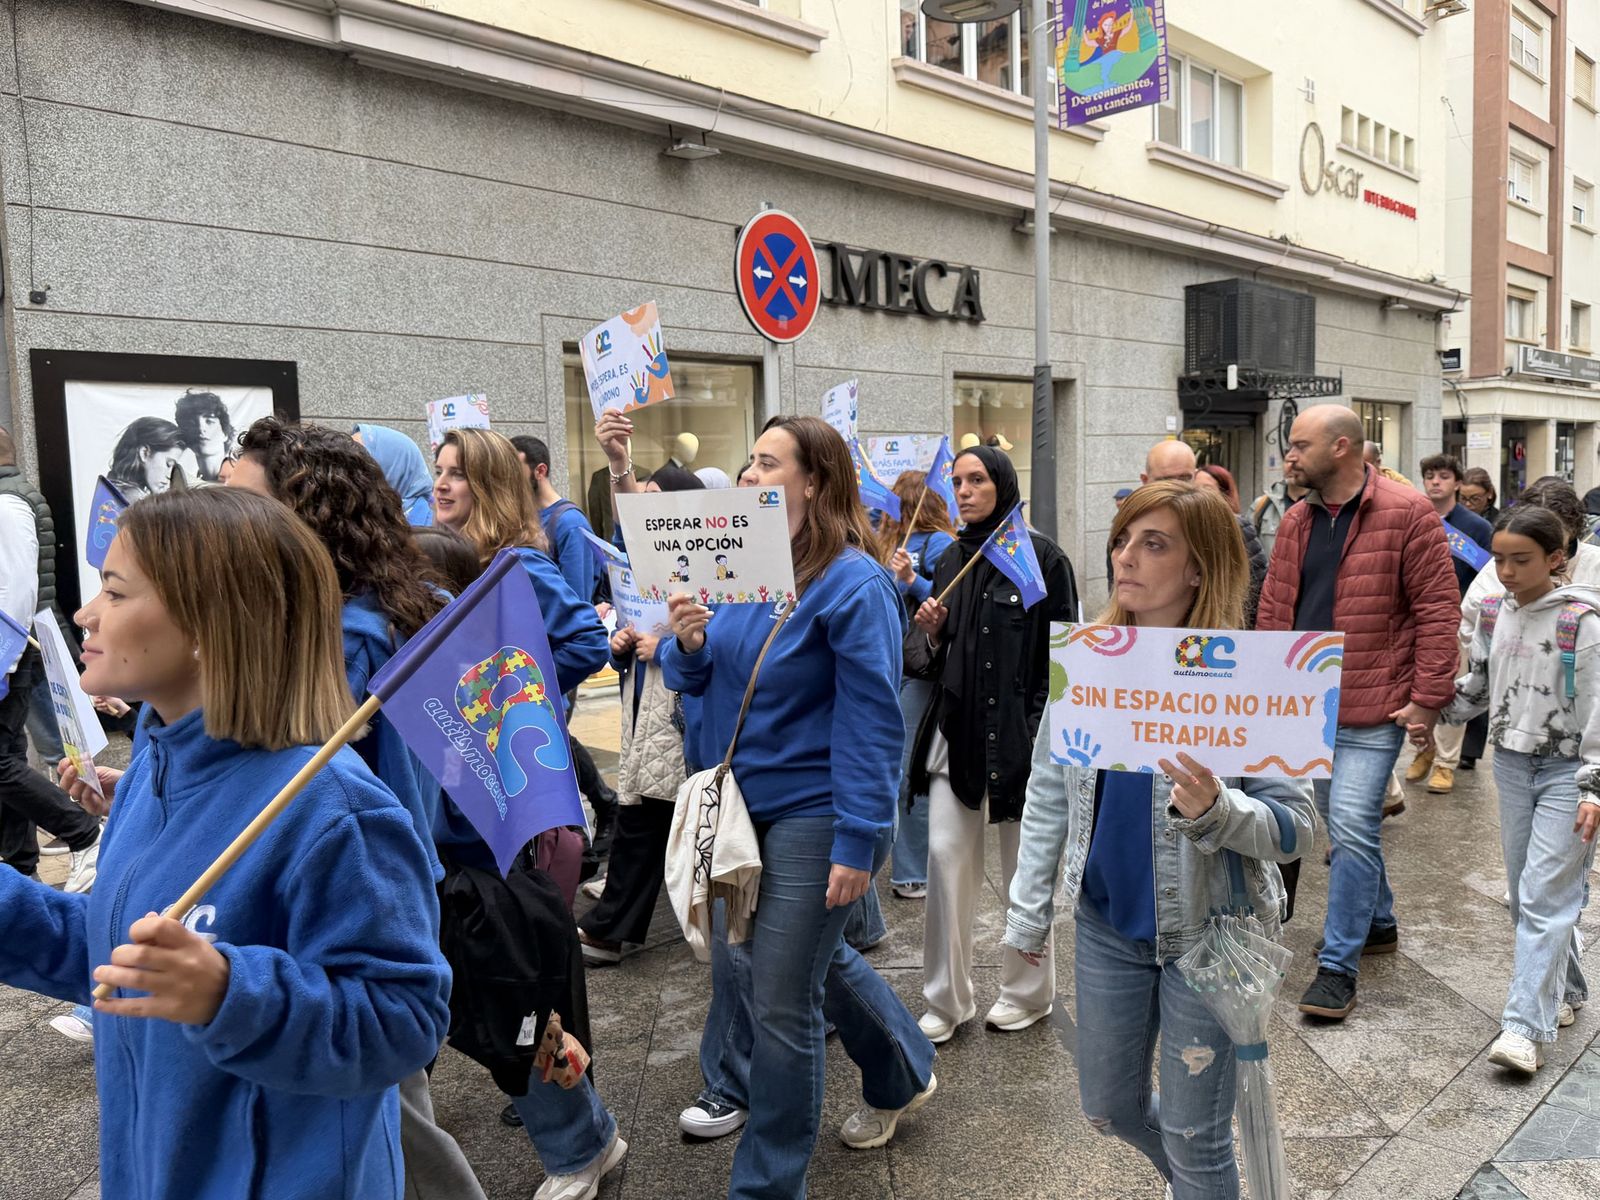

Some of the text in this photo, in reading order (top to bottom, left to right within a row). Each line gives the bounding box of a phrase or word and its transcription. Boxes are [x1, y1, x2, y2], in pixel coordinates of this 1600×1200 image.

[1071, 95, 1092, 107] Dos
[1085, 92, 1142, 116] una canción
[1299, 121, 1364, 200] Oscar
[645, 515, 749, 531] ESPERAR NO ES
[654, 533, 744, 551] UNA OPCIÓN
[1071, 685, 1316, 716] SIN ESPACIO NO HAY
[1131, 721, 1248, 747] TERAPIAS
